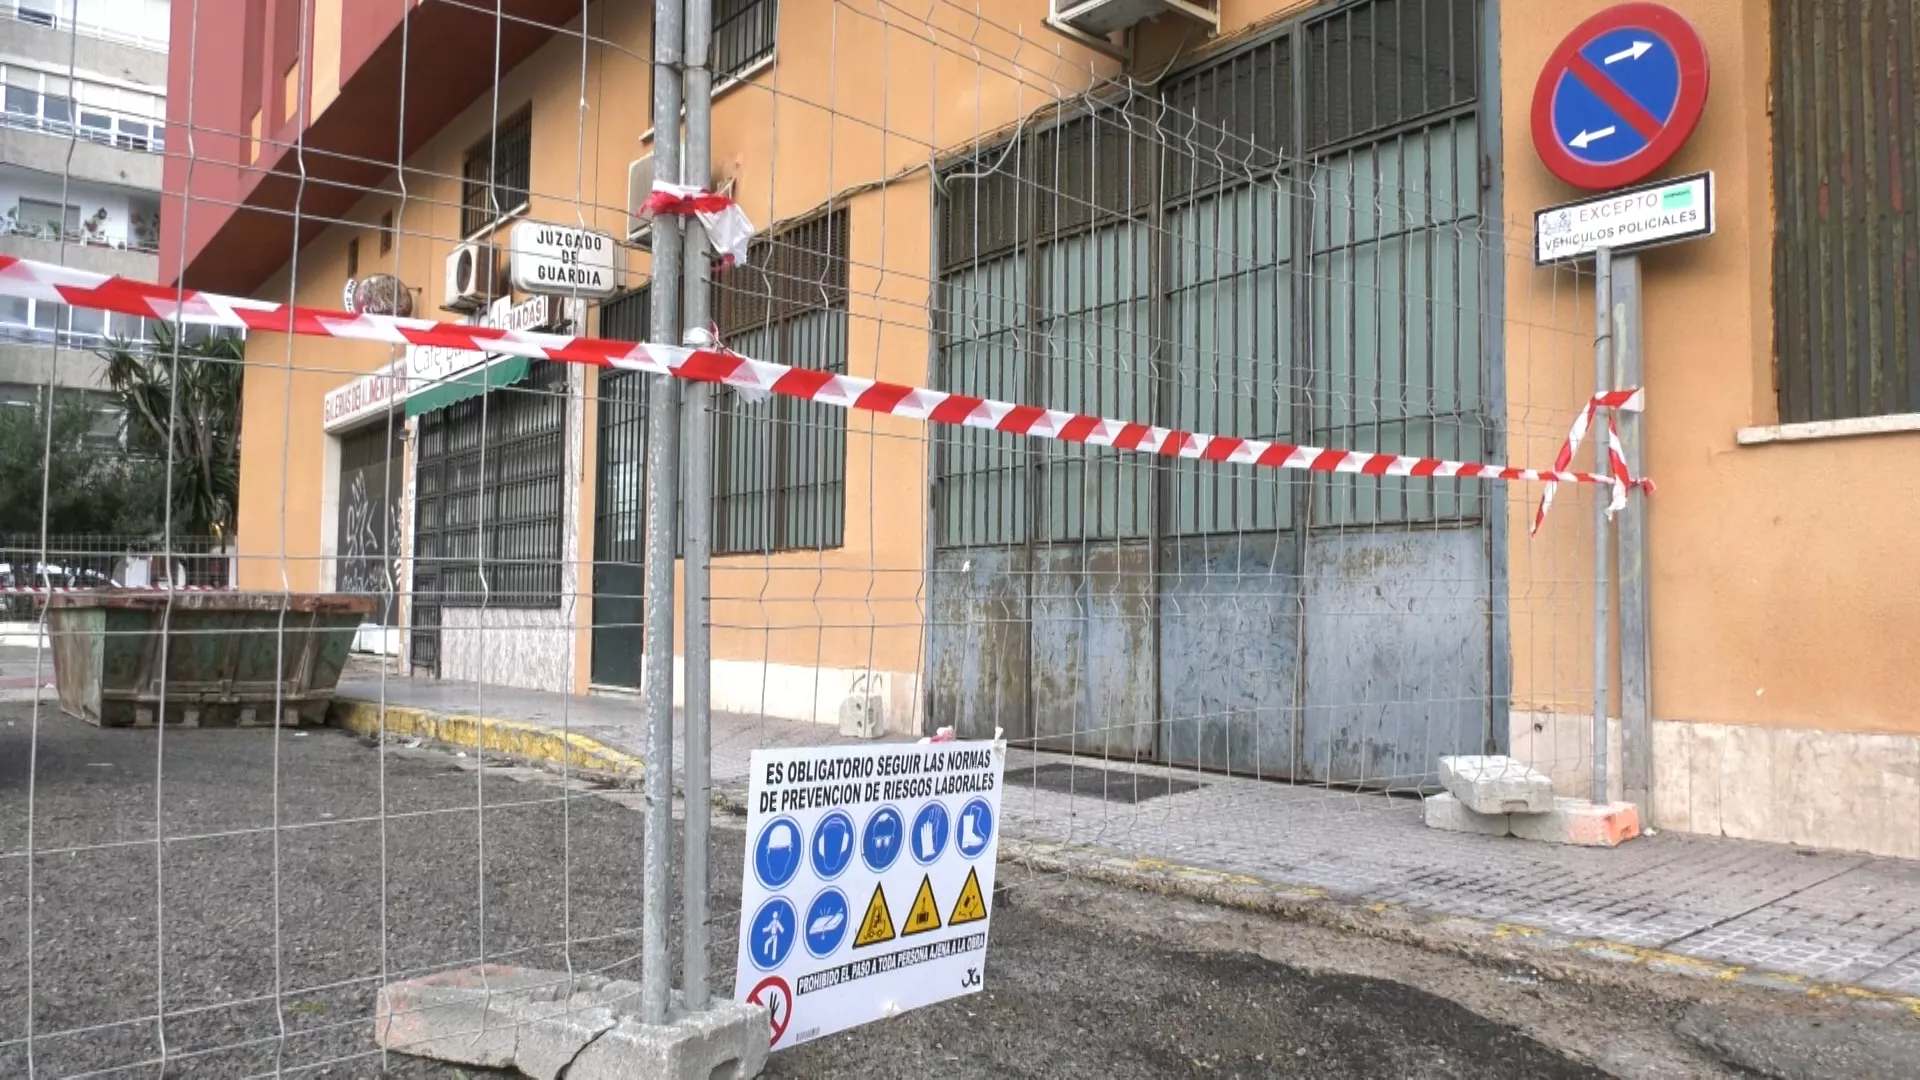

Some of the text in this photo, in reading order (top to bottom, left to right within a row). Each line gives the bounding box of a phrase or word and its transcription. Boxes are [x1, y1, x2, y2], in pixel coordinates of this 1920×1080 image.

[1580, 194, 1658, 222] EXCEPTO
[537, 230, 602, 250] JUZGADO
[1545, 209, 1697, 250] VEHICULOS POLICIALES
[562, 250, 577, 265] DE
[538, 265, 601, 286] GUARDIA
[766, 749, 991, 785] ES OBLIGATORIO SEGUIR LAS NORMAS
[760, 772, 994, 813] DE PREVENCION DE RIESGOS LABORALES
[798, 934, 984, 994] PROHIBIDO EL PASO A TODA PERSONA AJENA A LA OBRA
